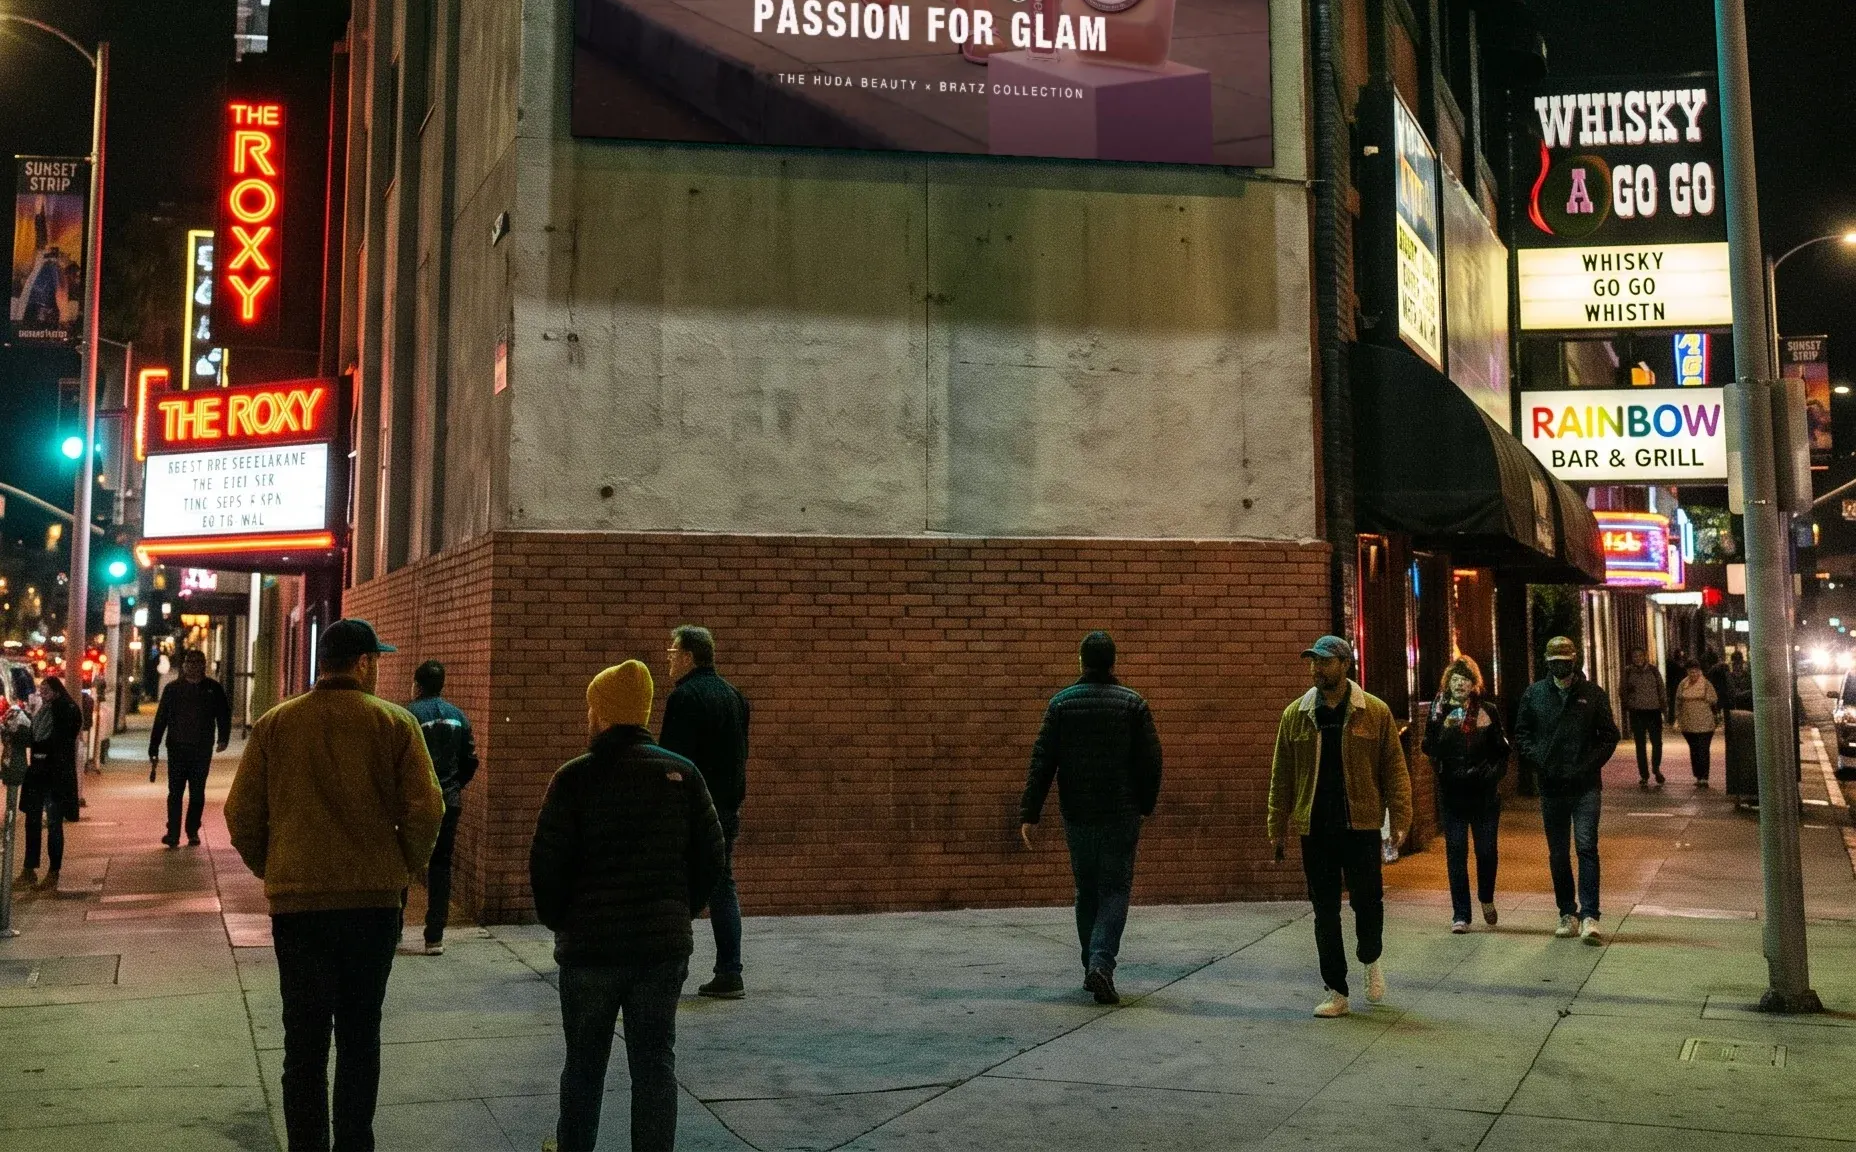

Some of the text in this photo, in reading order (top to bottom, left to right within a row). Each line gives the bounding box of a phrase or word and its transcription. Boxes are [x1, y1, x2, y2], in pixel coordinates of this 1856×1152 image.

[928, 8, 994, 46] FOR
[1012, 11, 1107, 52] GLAM
[778, 73, 805, 85] THE
[814, 75, 852, 87] HUDA
[861, 77, 917, 91] BEAUTY
[939, 81, 985, 95] BRATZ
[993, 84, 1084, 99] COLLECTION
[229, 103, 280, 126] THE
[1534, 88, 1707, 149] WHISKY
[25, 161, 77, 178] SUNSET
[30, 177, 71, 192] STRIP
[1566, 162, 1715, 219] A GO GO
[228, 129, 277, 322] ROXY
[1582, 251, 1664, 272] WHISKY
[1593, 277, 1655, 297] GO GO
[1585, 302, 1665, 322] WHISTN
[158, 386, 326, 442] THE ROXY
[1532, 404, 1721, 439] RAINBOW
[1552, 448, 1704, 468] BAR & GRILL
